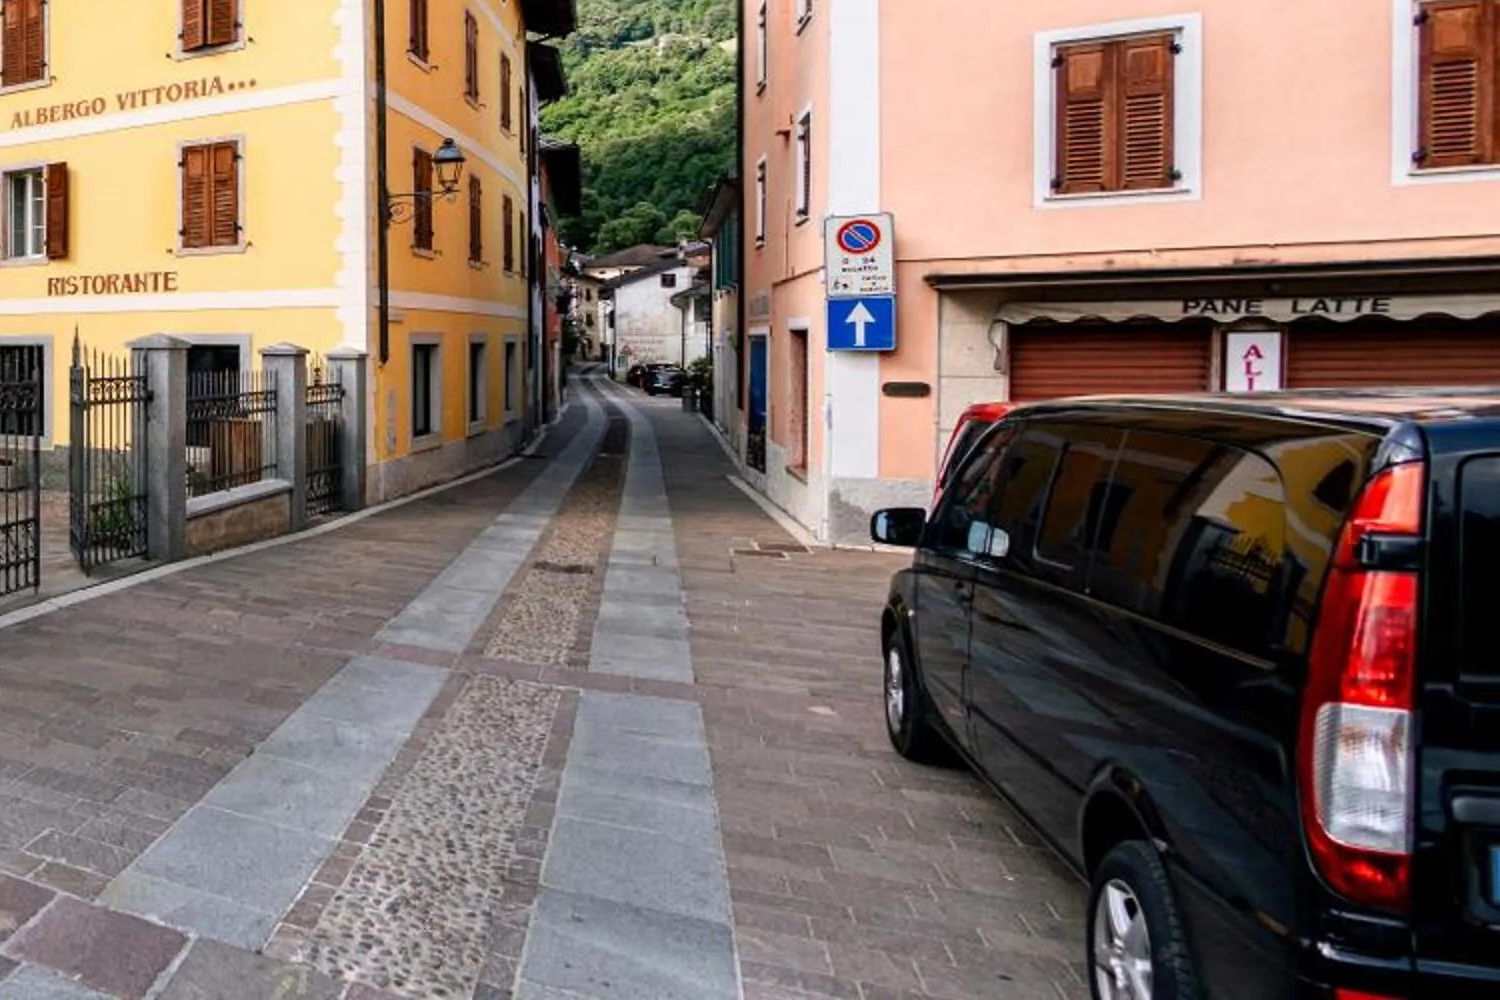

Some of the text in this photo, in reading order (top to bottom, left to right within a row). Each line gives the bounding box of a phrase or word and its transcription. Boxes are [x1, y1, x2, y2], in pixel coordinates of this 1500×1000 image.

[10, 96, 106, 130] ALBERGO
[47, 271, 179, 297] RISTORANTE
[1182, 297, 1391, 315] PANE LATTE
